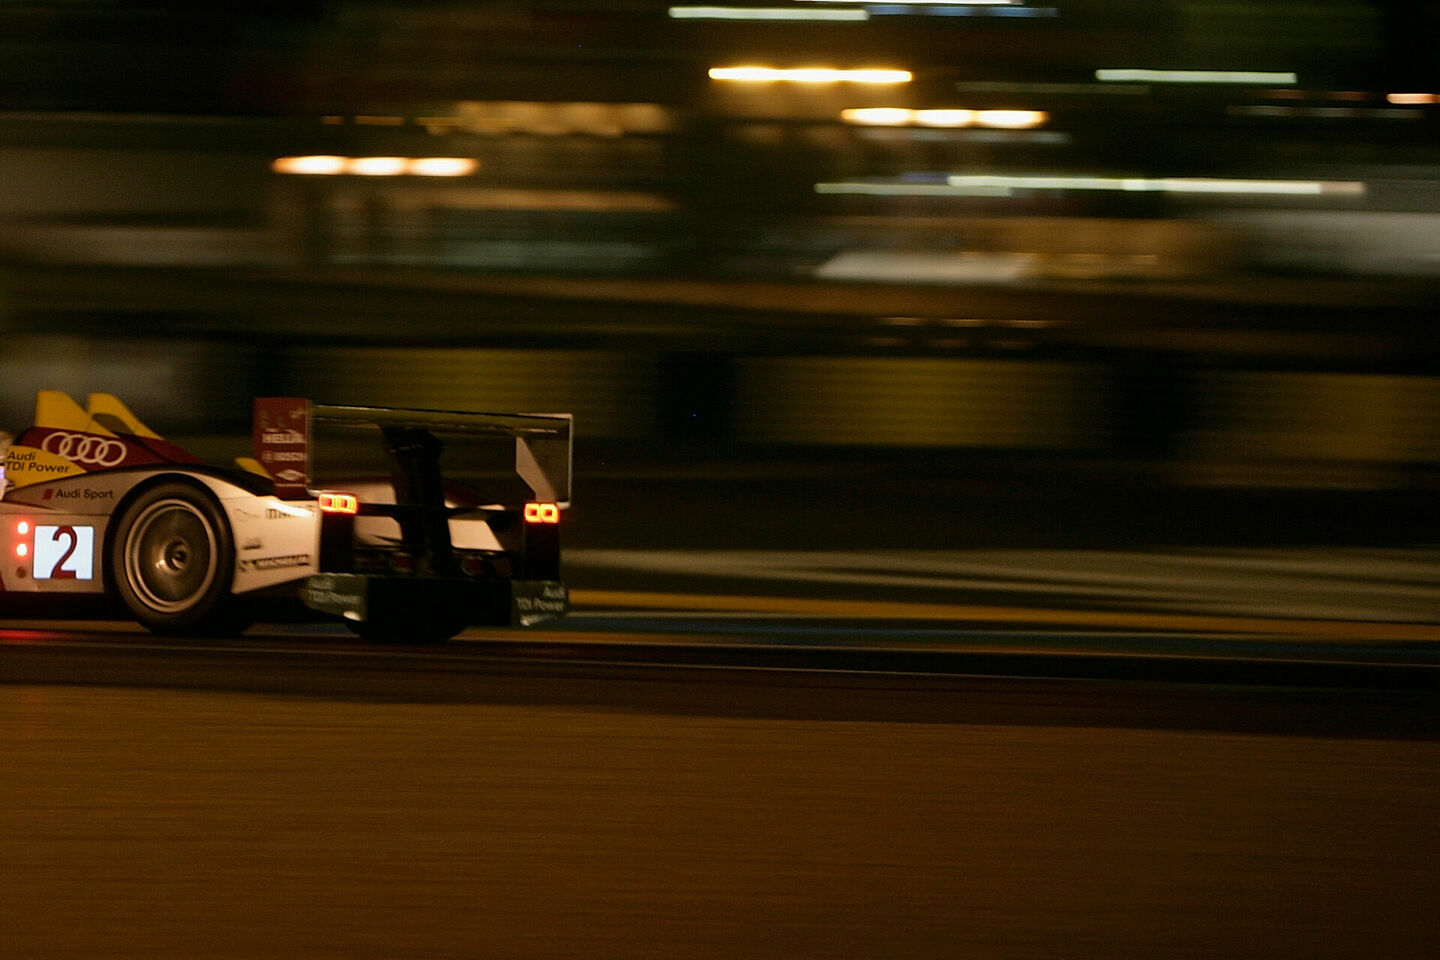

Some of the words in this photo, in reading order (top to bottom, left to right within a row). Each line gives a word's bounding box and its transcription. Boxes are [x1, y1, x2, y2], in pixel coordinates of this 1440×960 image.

[7, 451, 36, 462] Audi
[5, 461, 25, 471] TDI
[29, 462, 71, 473] Power
[55, 488, 81, 498] Audi
[83, 488, 114, 500] Sport
[50, 525, 78, 580] 2
